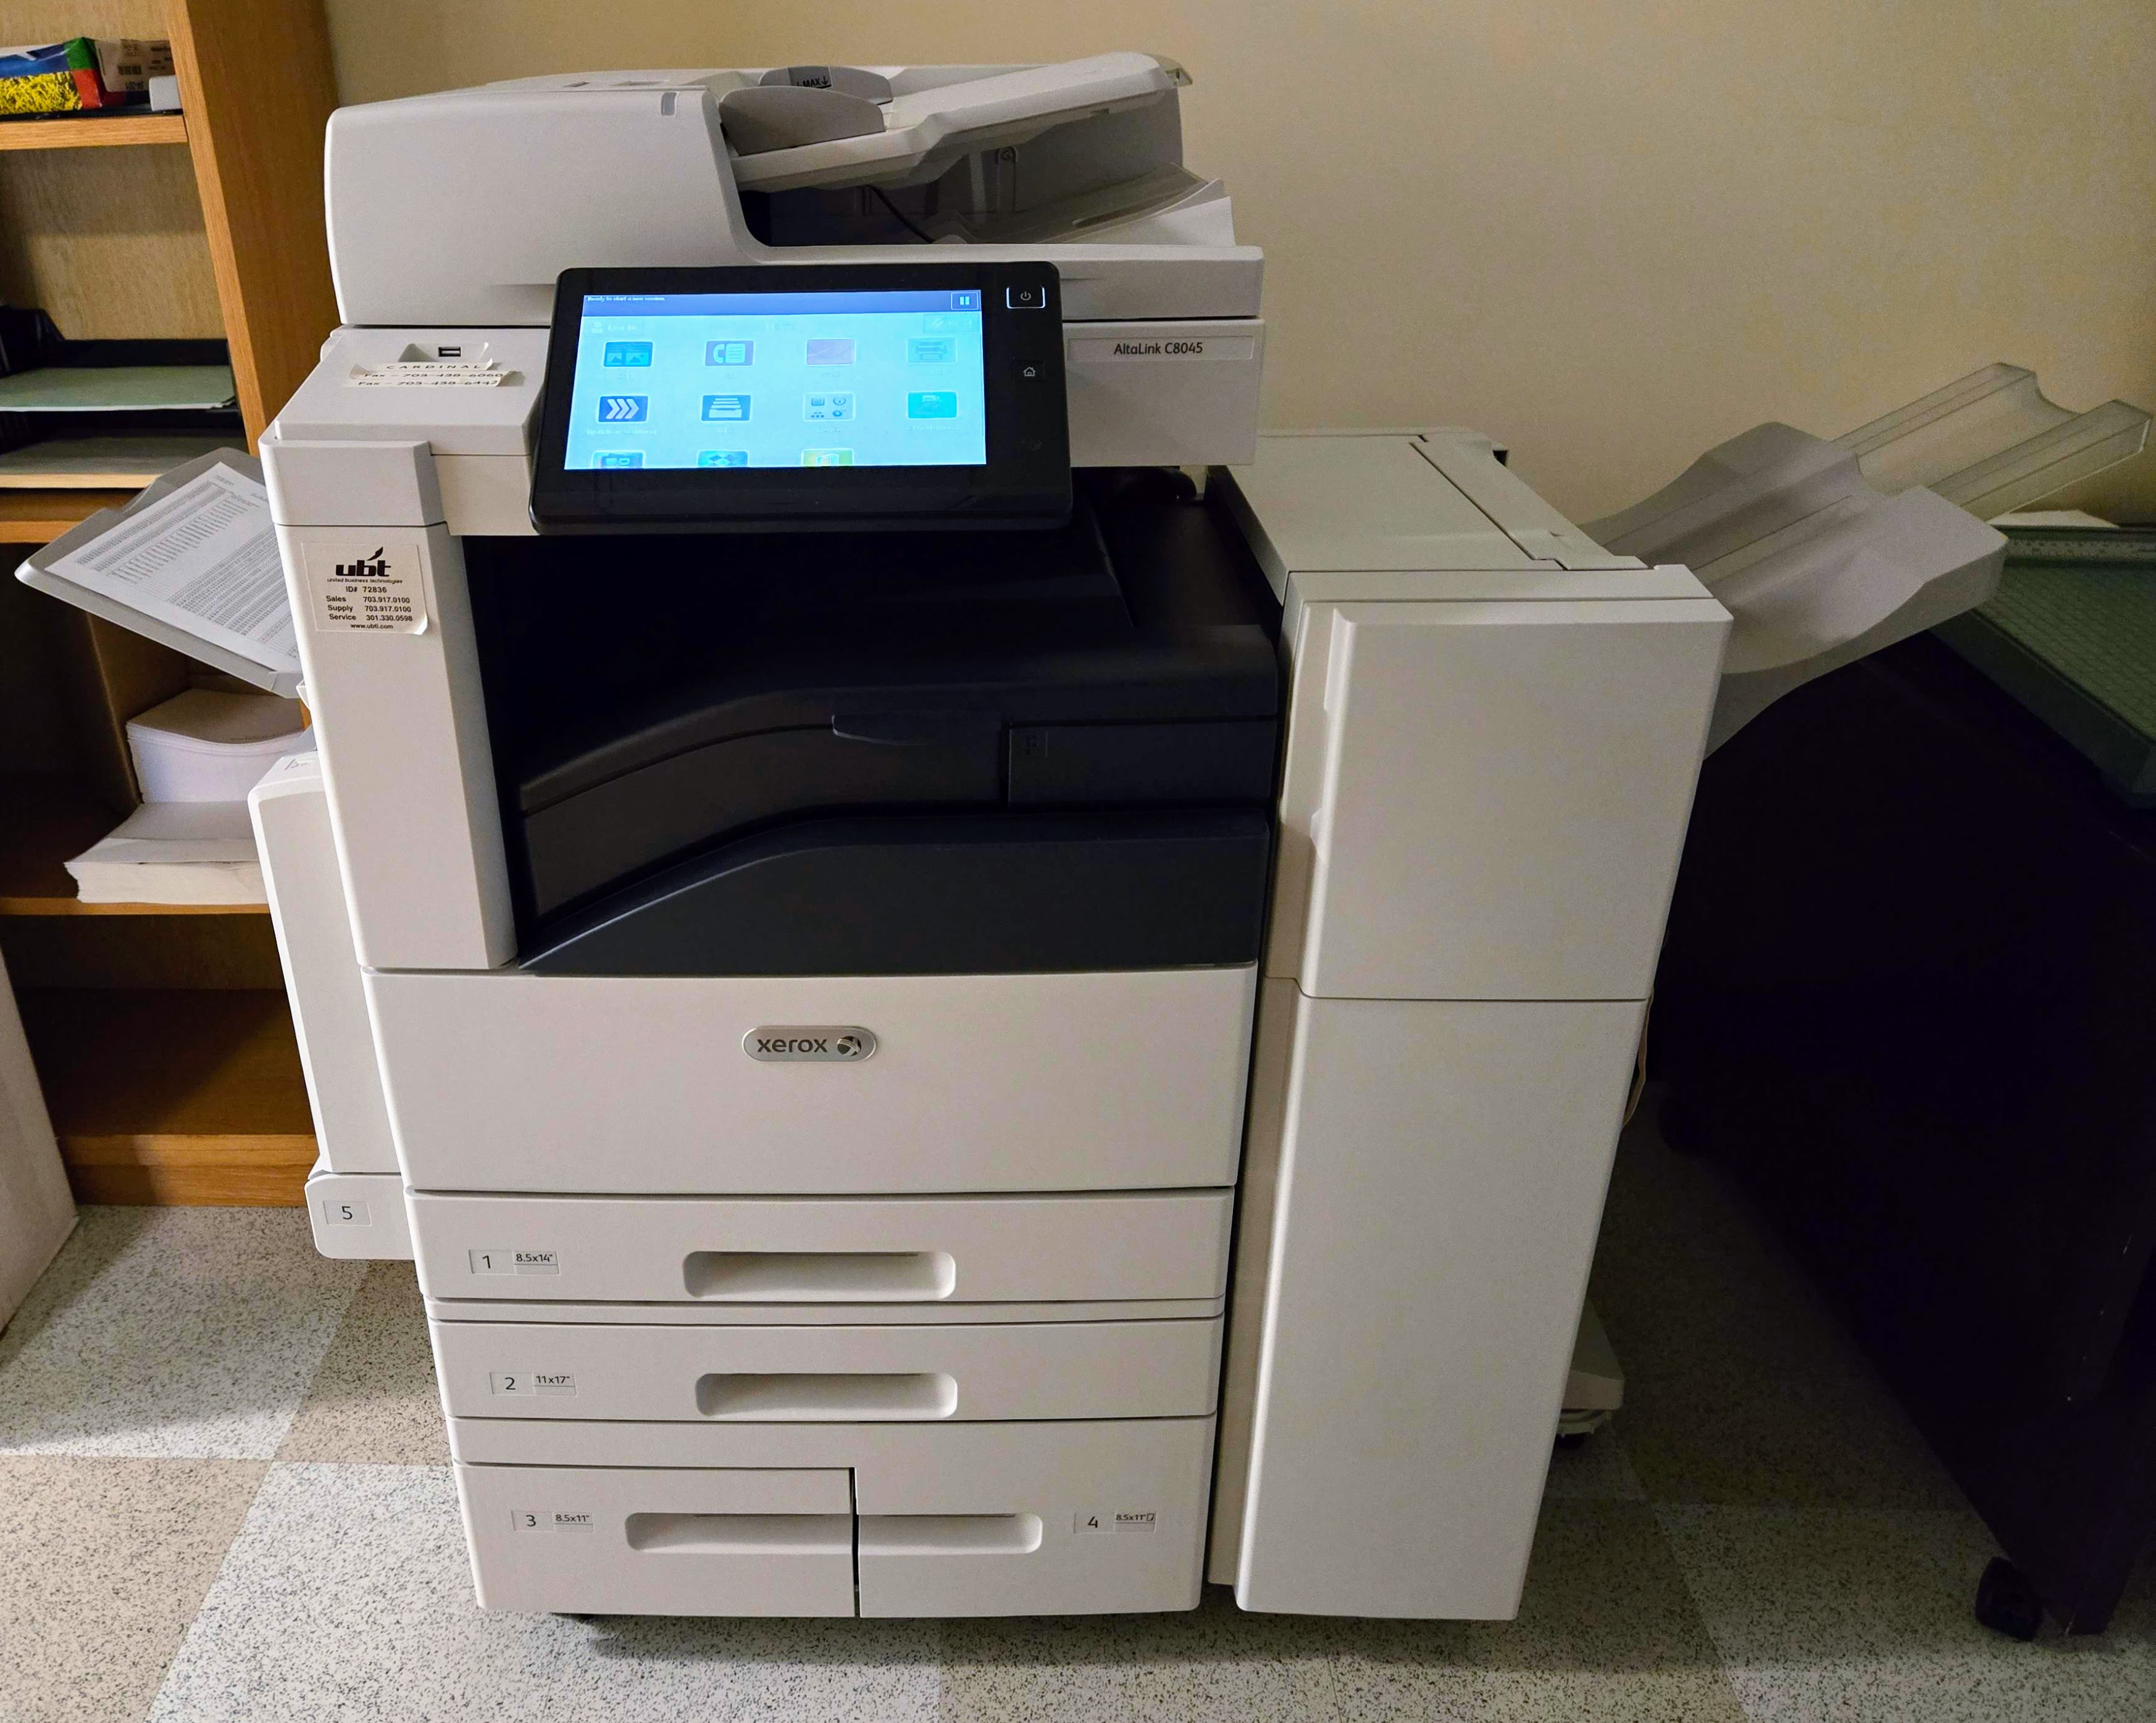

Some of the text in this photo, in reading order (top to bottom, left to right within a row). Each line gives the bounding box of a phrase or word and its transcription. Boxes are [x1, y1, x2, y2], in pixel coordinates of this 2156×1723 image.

[803, 78, 820, 87] MAX
[1113, 342, 1203, 355] AltaLink C8045
[335, 559, 391, 577] ubt
[757, 1038, 828, 1053] xerox
[341, 1206, 353, 1220] 5
[482, 1255, 491, 1269] 1
[504, 1377, 516, 1390] 2
[525, 1514, 537, 1527] 3
[1087, 1516, 1099, 1529] 4
